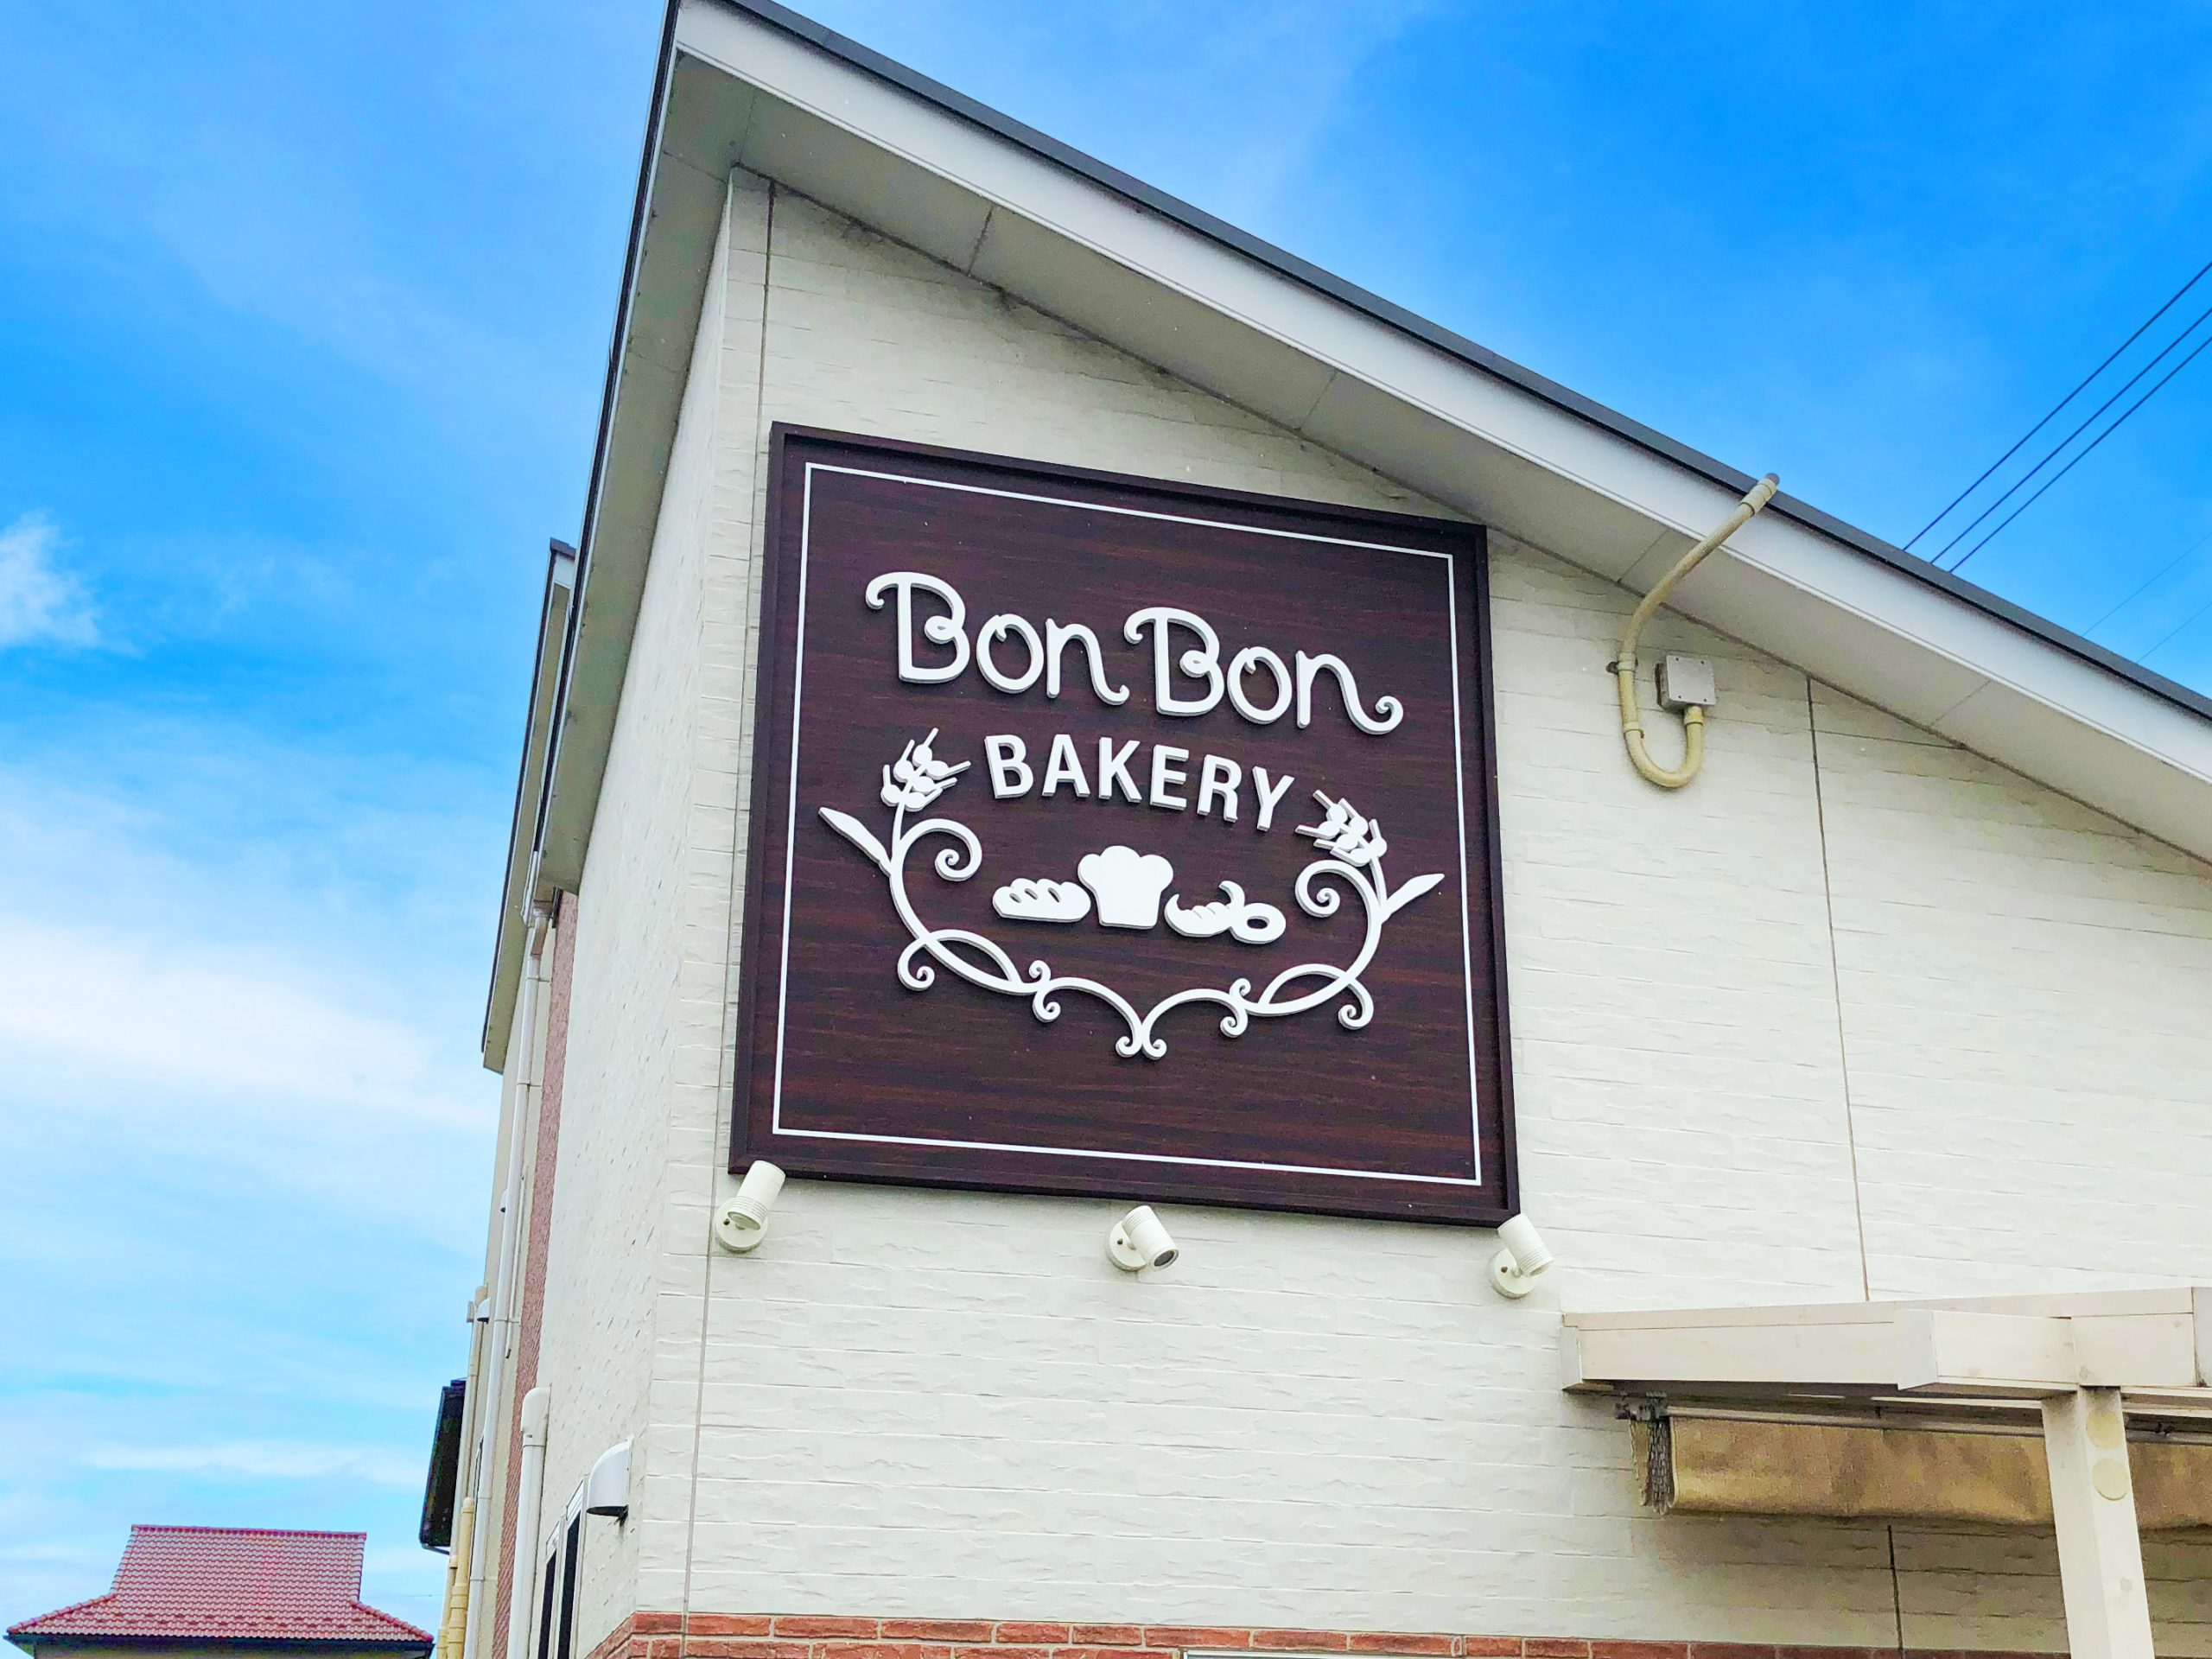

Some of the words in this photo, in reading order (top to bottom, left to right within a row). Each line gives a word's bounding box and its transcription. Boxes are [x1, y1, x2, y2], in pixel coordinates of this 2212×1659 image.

[865, 571, 1130, 706] Bon
[1124, 607, 1404, 734] Bon
[983, 733, 1295, 831] BAKERY
